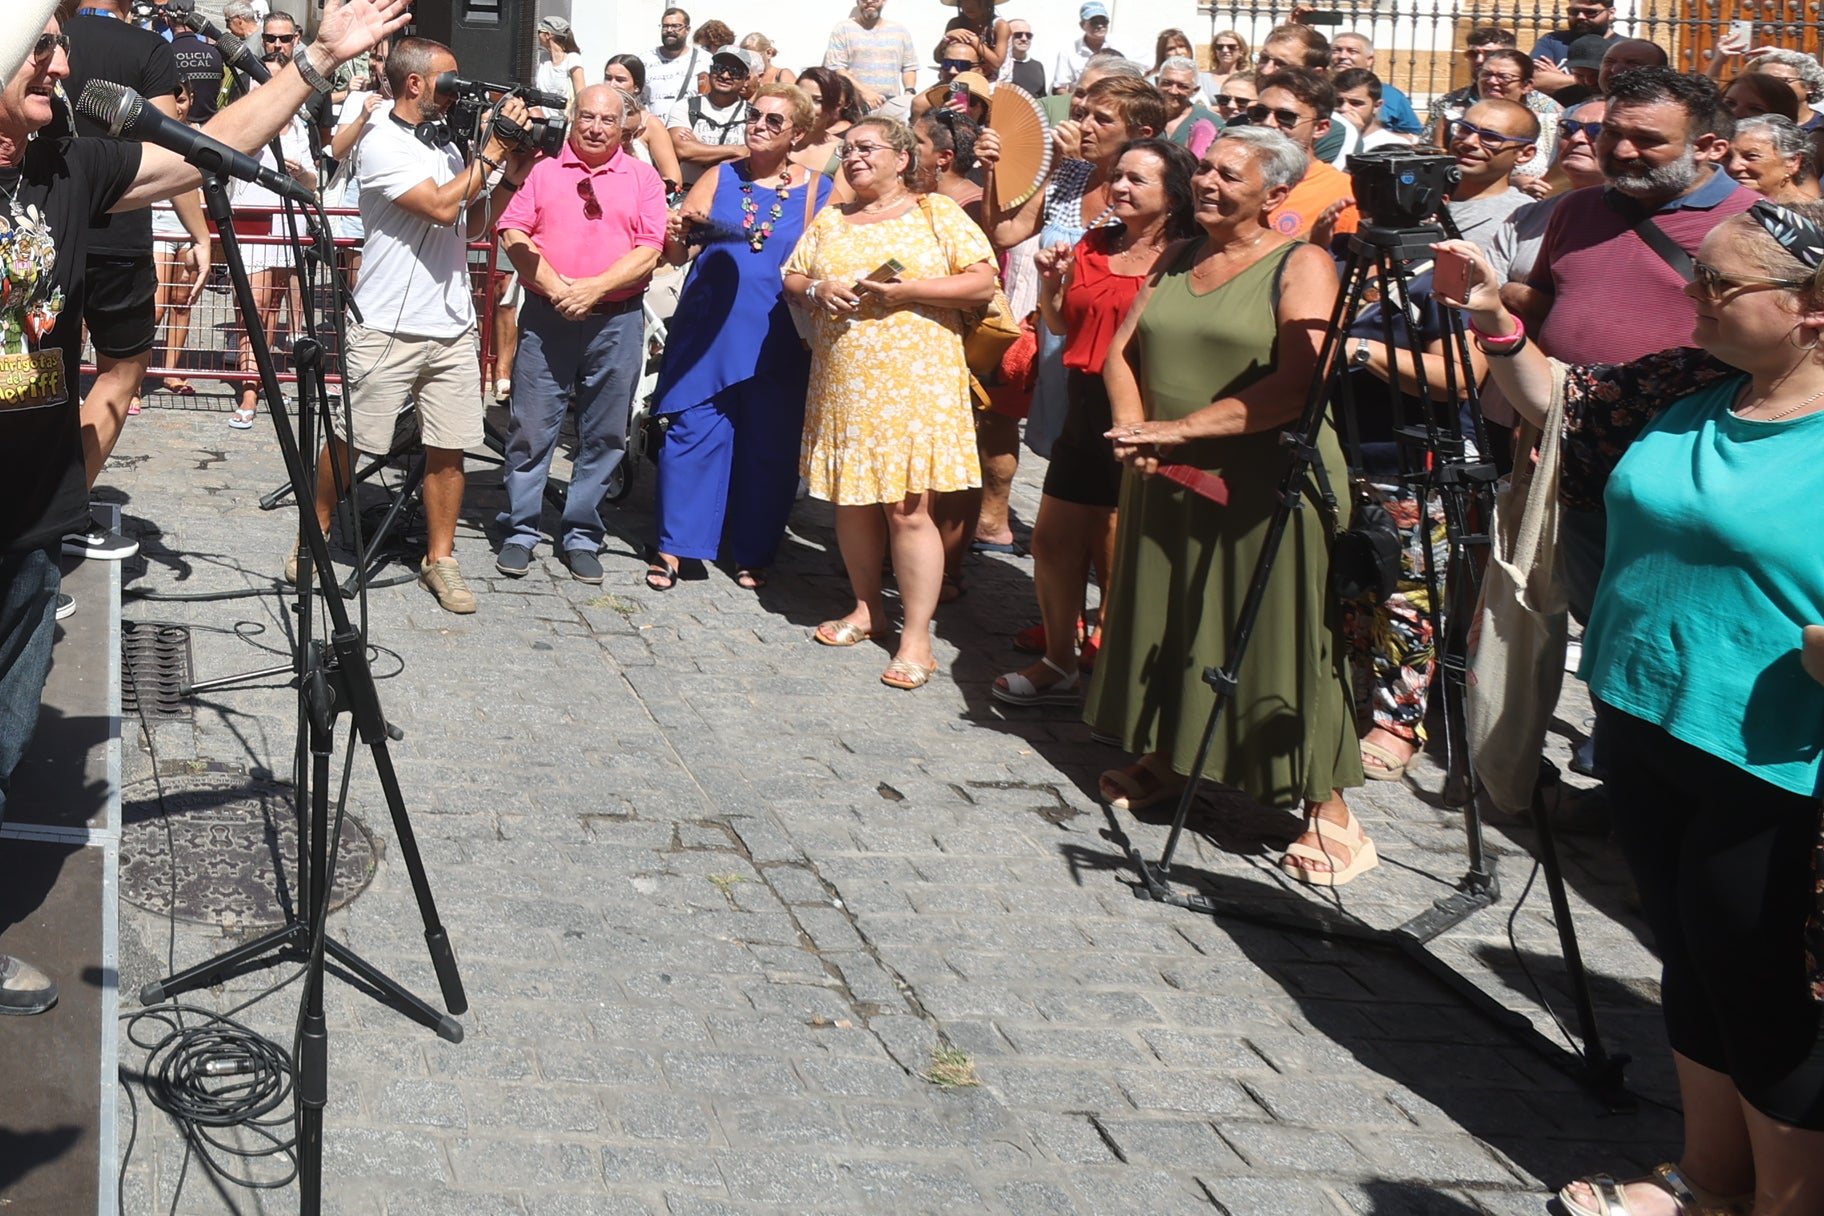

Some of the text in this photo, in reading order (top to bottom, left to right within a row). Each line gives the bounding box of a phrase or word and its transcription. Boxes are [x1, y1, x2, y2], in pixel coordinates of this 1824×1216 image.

[174, 52, 213, 60] OLICIA
[176, 60, 211, 69] LOCAL
[6, 372, 23, 385] del
